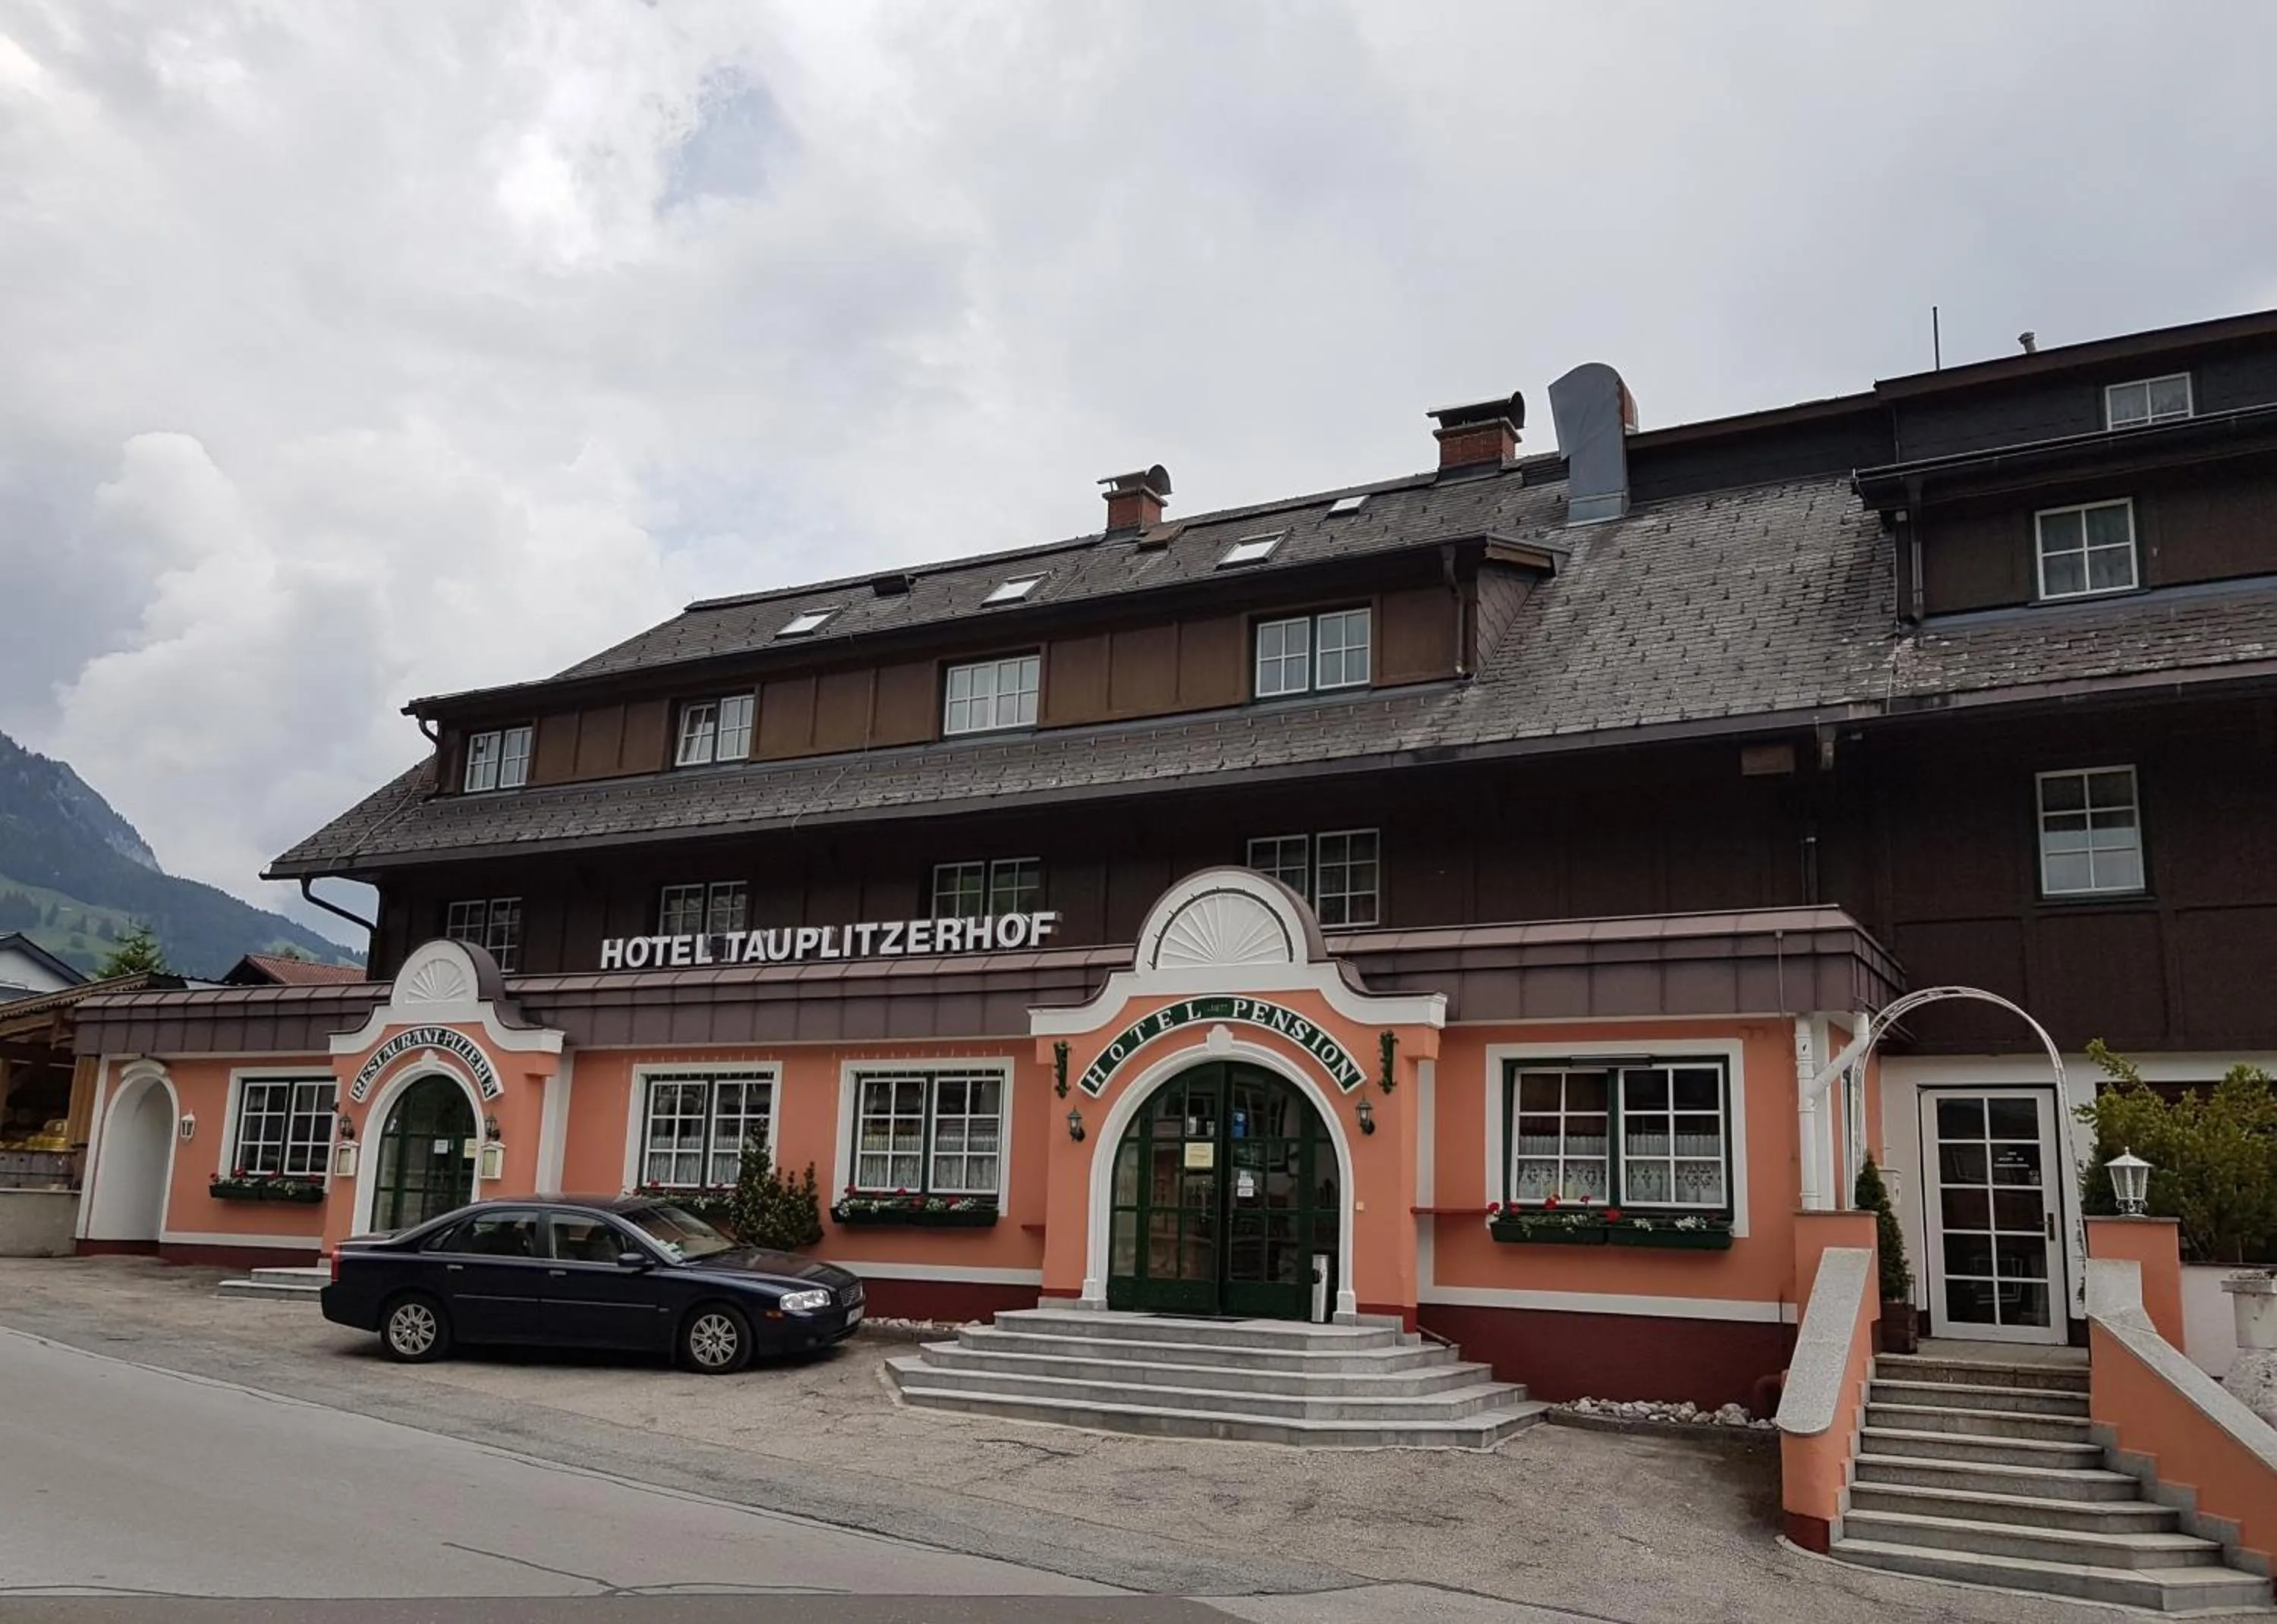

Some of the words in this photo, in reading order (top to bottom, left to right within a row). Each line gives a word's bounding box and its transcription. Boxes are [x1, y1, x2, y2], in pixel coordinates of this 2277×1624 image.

[600, 934, 712, 968] HOTEL
[724, 911, 1057, 962] TAUPLITZERHOF
[1085, 1005, 1202, 1090] HOTEL
[1232, 1000, 1356, 1084] PENSION
